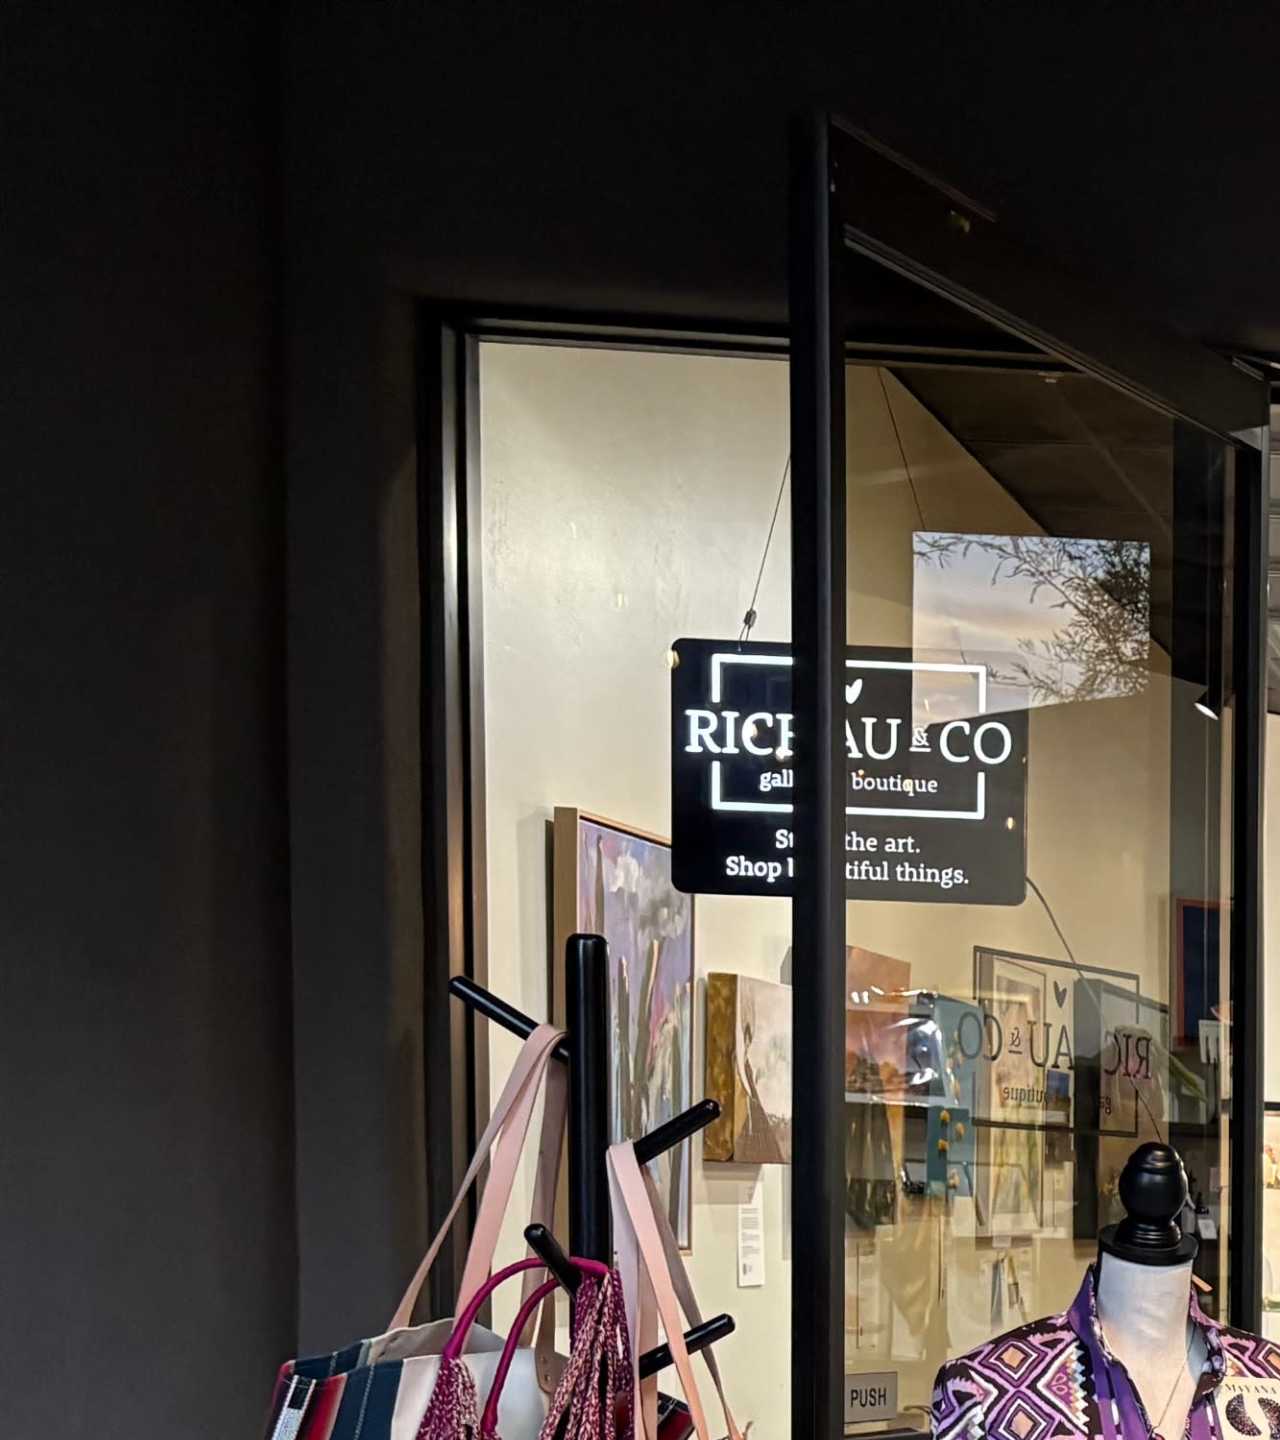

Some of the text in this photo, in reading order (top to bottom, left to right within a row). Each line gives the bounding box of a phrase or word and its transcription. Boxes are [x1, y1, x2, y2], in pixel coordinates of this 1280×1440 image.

[910, 727, 931, 748] &
[939, 721, 1013, 765] CO
[852, 773, 938, 796] boutique
[845, 831, 921, 853] the art.
[726, 856, 782, 882] Shop
[896, 863, 969, 887] things.
[850, 1388, 887, 1407] PUSH
